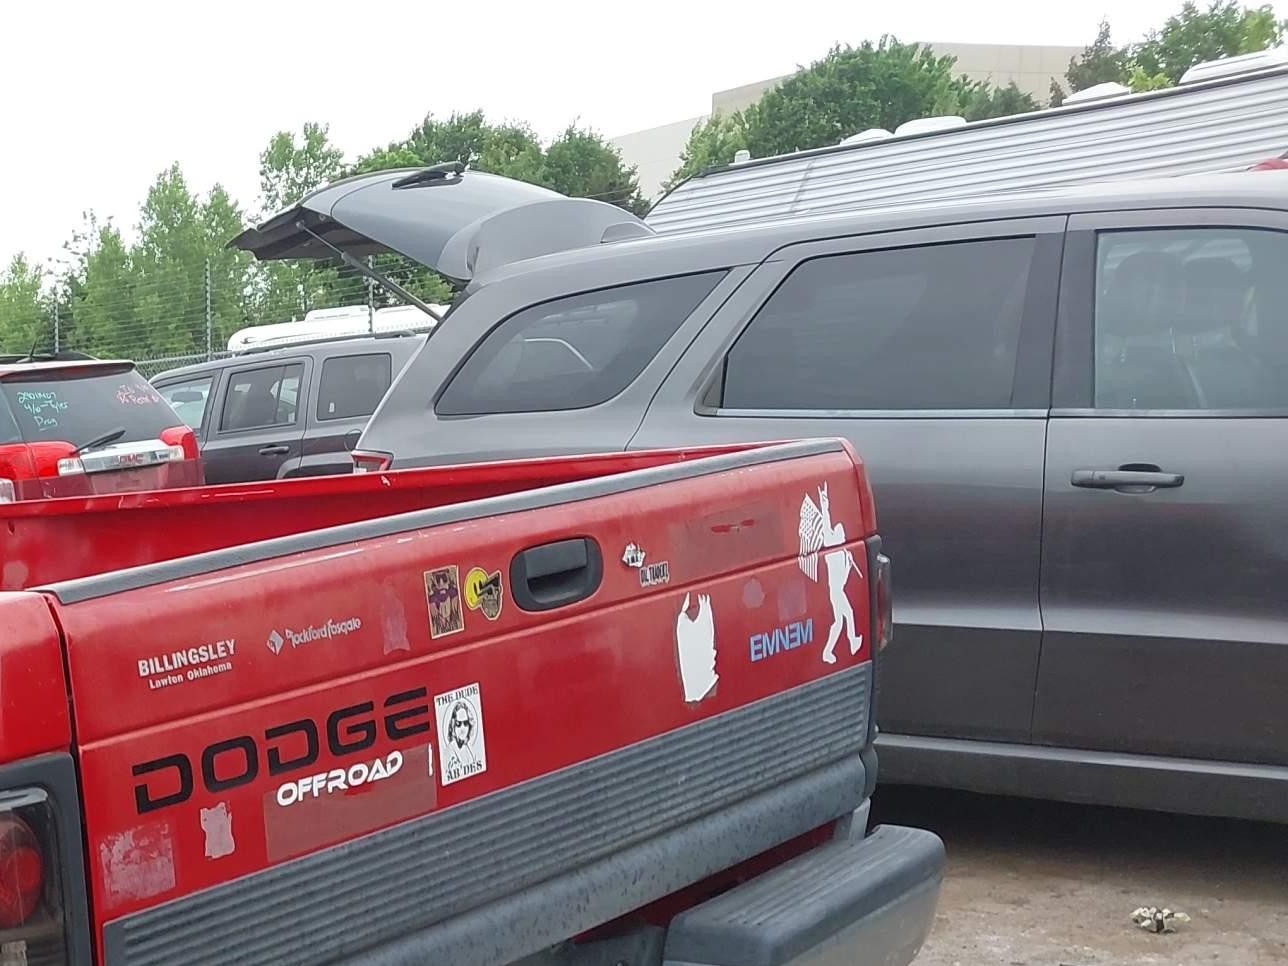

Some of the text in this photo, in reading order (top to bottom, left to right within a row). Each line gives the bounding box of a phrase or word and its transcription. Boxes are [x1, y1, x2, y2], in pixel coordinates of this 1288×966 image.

[137, 639, 236, 677] BILLINGSLEY
[149, 661, 232, 689] Lawton Oklahoma
[436, 685, 479, 707] THE DUDE
[131, 687, 431, 815] DODGE
[276, 750, 404, 807] OFFROAD
